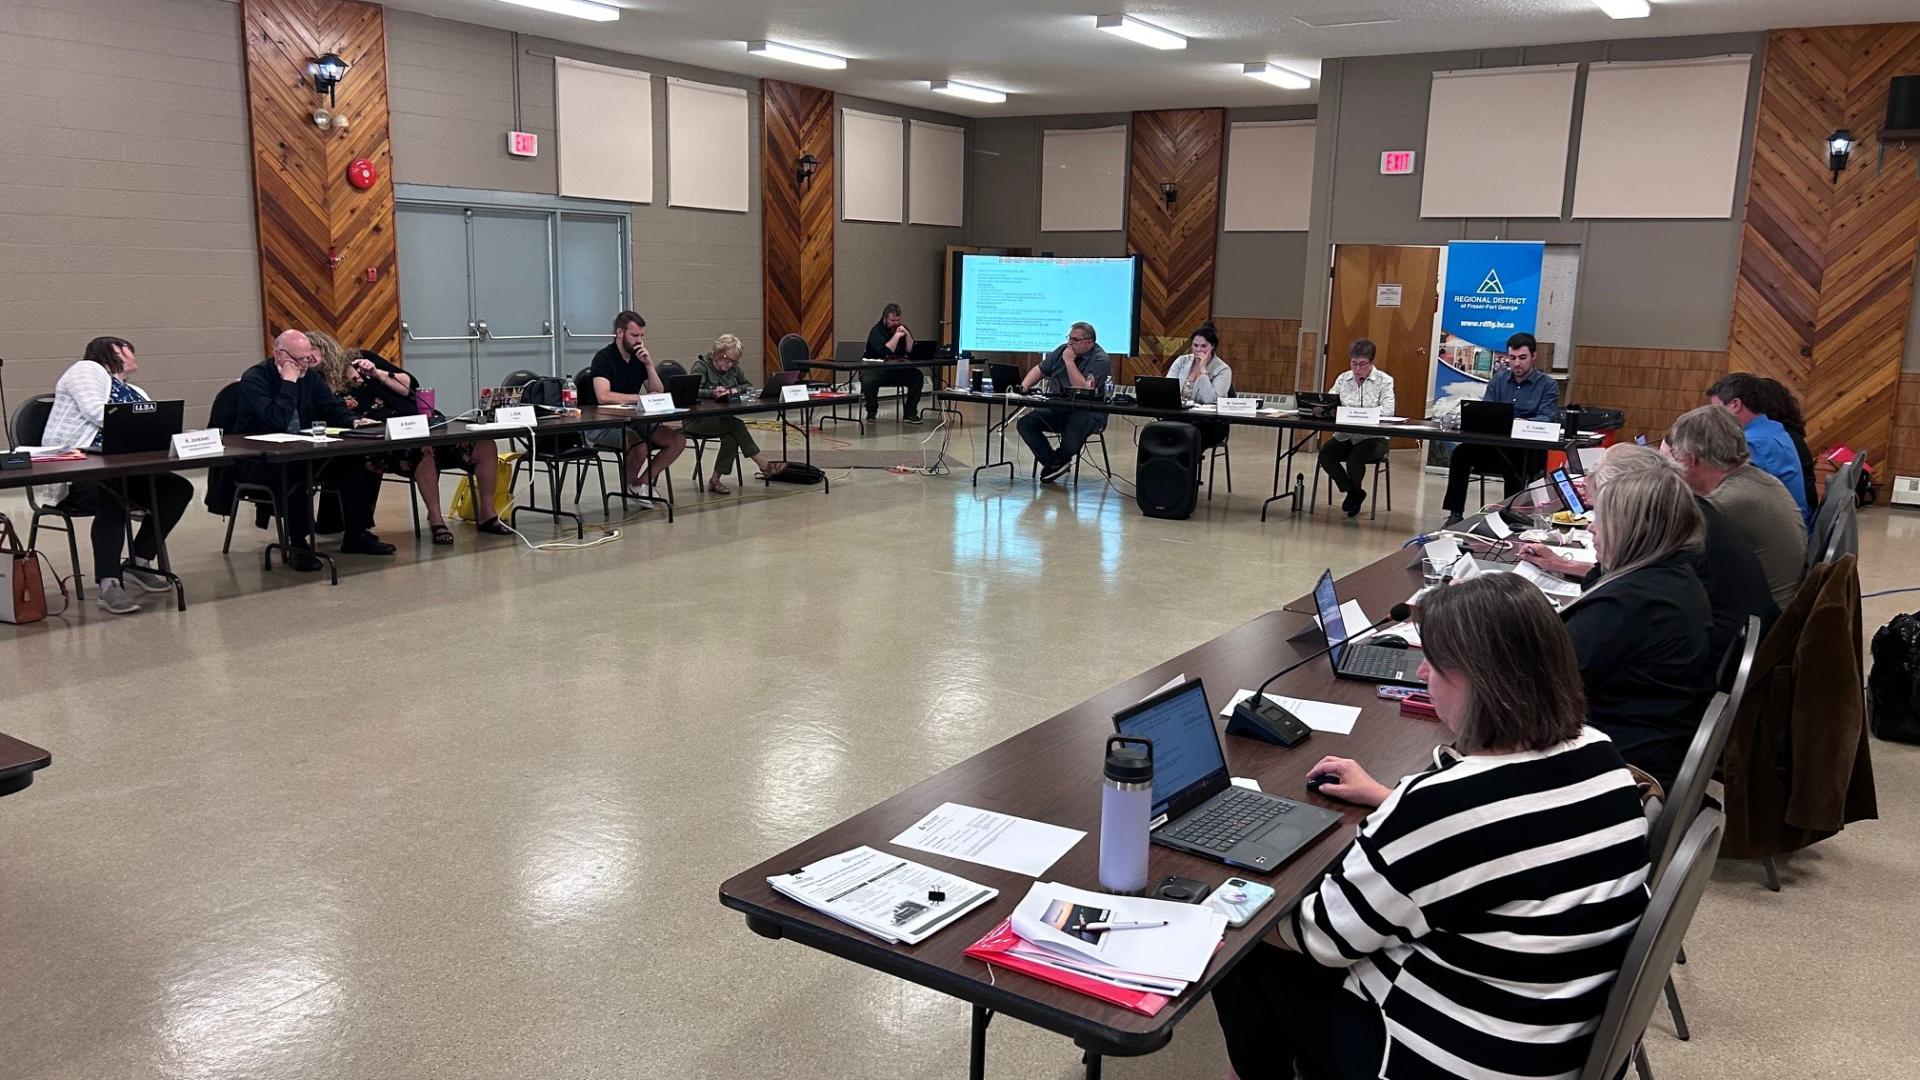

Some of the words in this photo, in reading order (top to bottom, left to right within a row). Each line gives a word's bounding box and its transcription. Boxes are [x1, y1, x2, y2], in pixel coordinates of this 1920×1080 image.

[1386, 153, 1409, 172] EXIT
[1454, 295, 1491, 304] REGIONAL
[1493, 297, 1527, 305] DISTRICT
